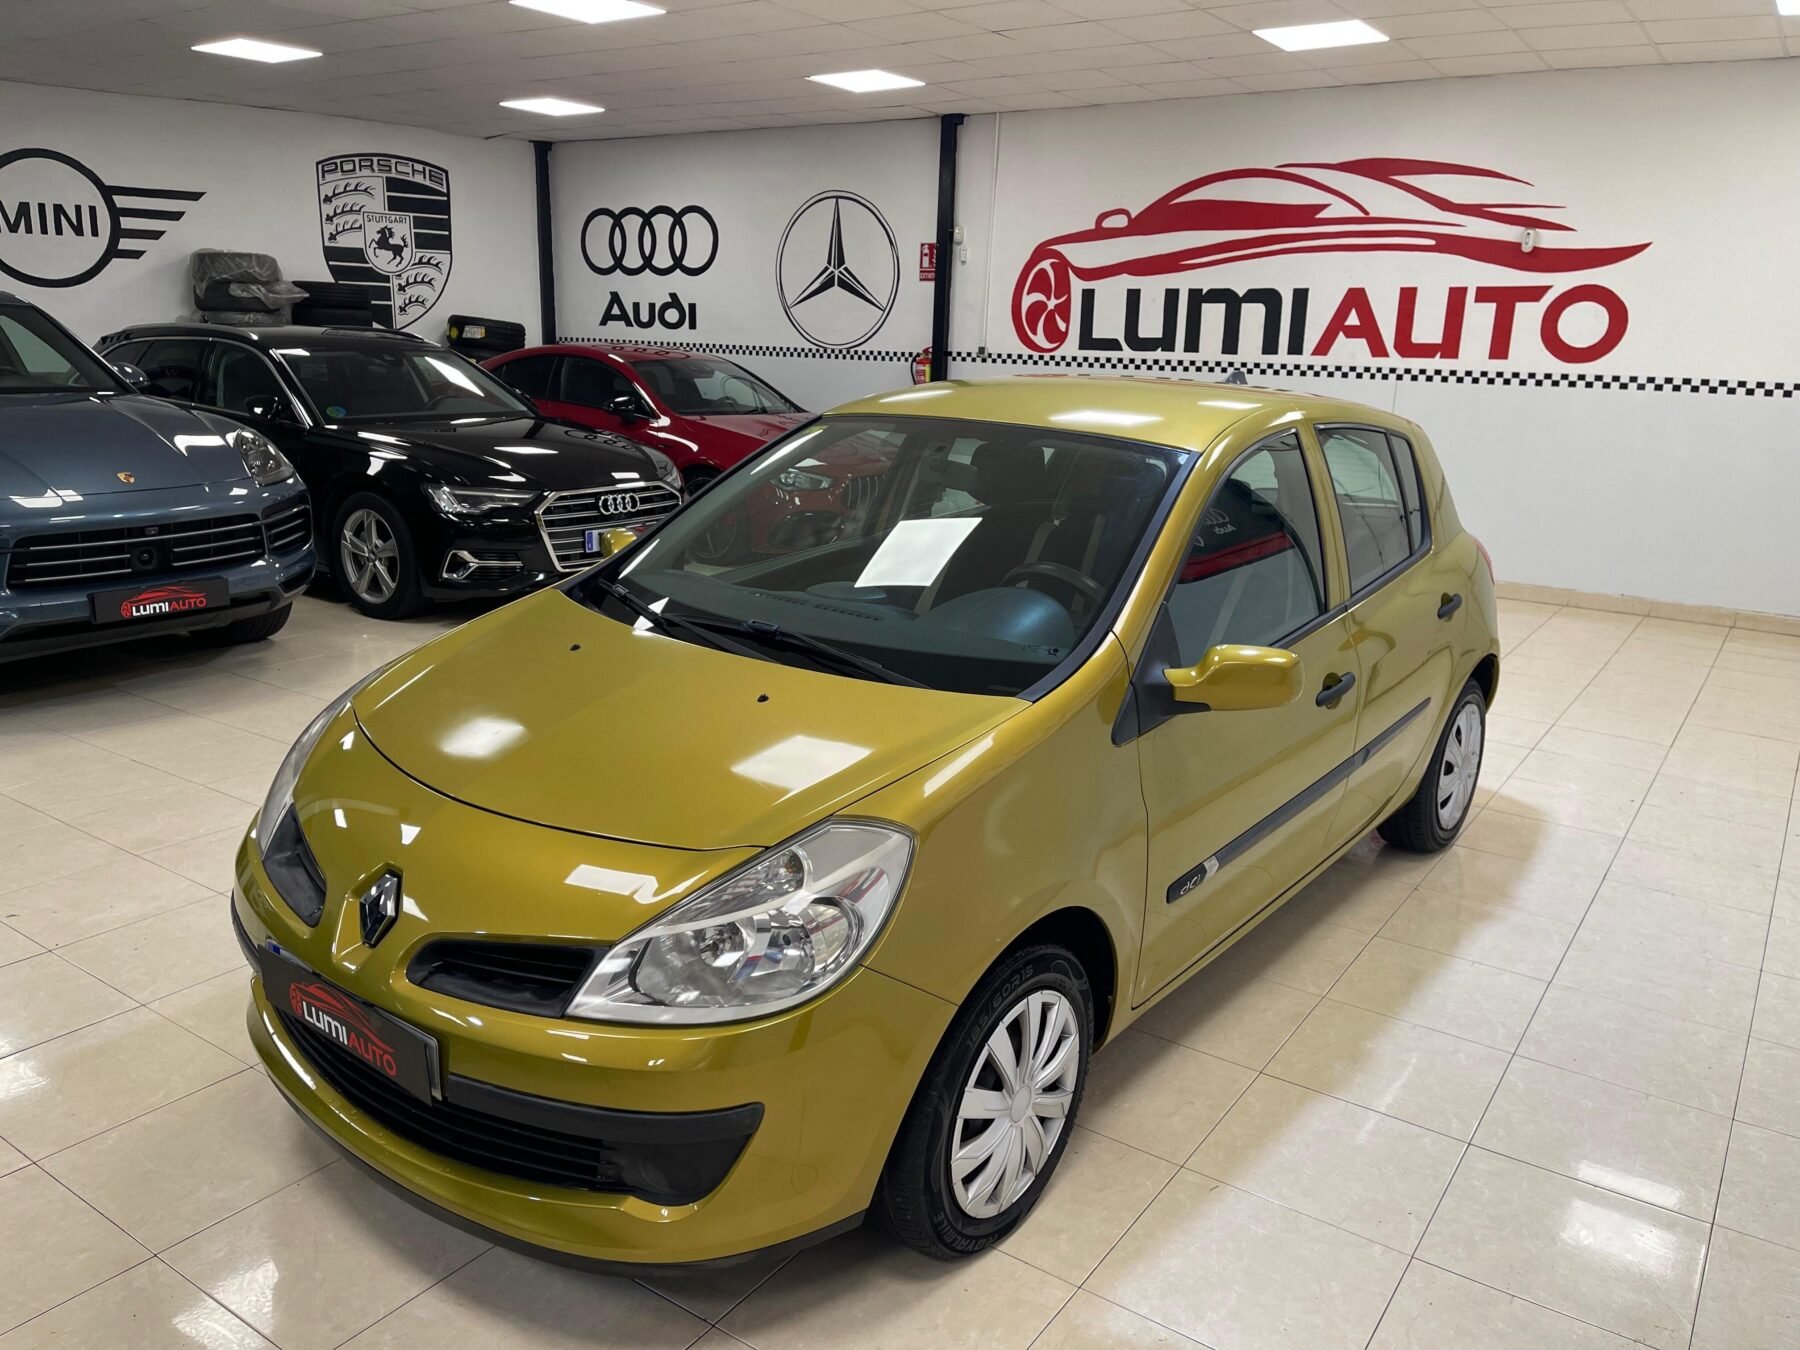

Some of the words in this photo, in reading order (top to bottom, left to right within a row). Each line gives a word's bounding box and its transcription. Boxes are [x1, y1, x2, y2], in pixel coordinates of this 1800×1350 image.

[320, 158, 446, 189] PORSCHE
[0, 201, 99, 237] MINI
[366, 214, 408, 224] STUTTGART
[598, 291, 697, 330] Audi
[1180, 874, 1200, 895] dCi
